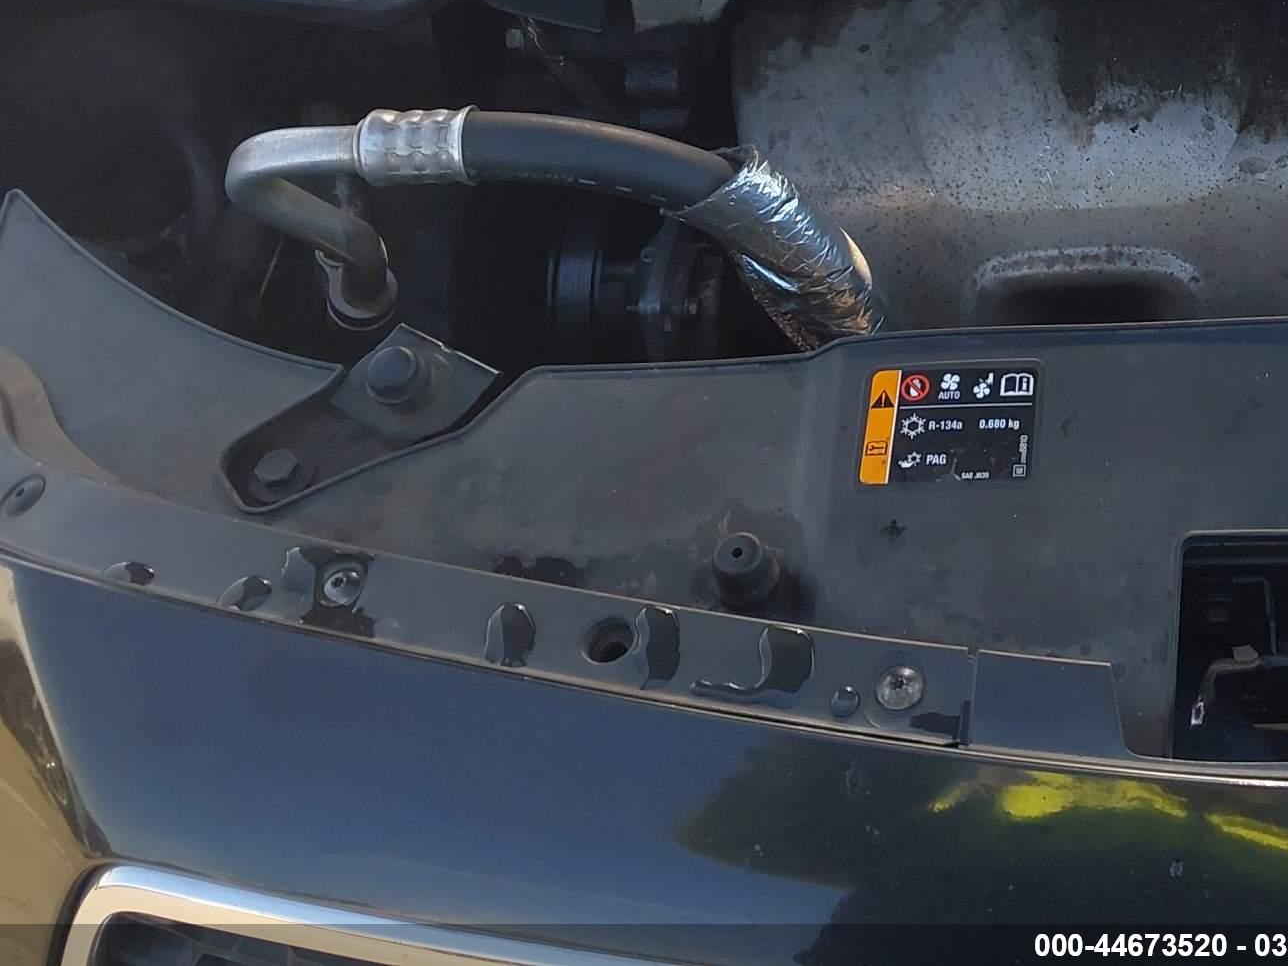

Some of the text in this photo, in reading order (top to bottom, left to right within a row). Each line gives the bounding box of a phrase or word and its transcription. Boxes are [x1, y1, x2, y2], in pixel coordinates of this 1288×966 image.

[938, 391, 960, 400] AUTO
[928, 419, 963, 431] R-134a
[1008, 418, 1020, 431] kg
[926, 454, 947, 465] PAG
